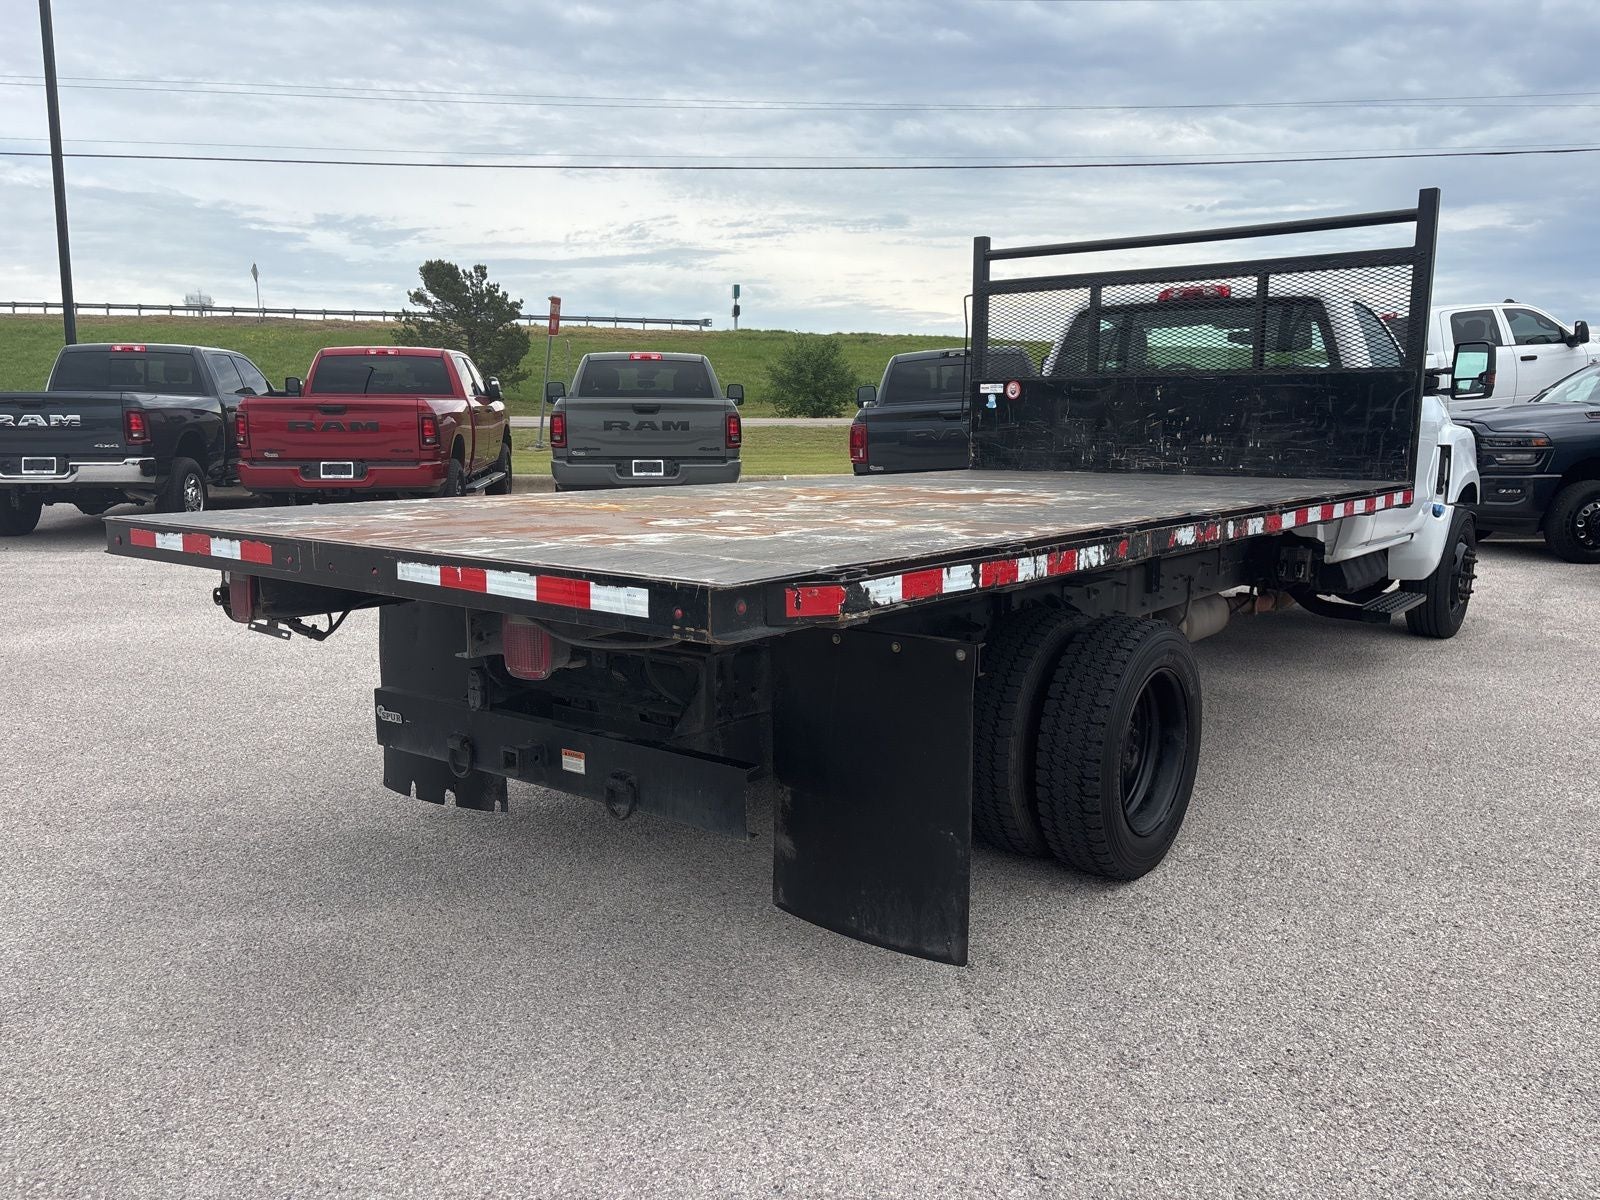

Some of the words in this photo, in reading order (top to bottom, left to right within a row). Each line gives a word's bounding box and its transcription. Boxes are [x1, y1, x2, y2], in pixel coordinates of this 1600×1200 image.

[287, 421, 380, 432] RAM
[603, 420, 690, 431] RAM
[381, 711, 402, 722] SPUR
